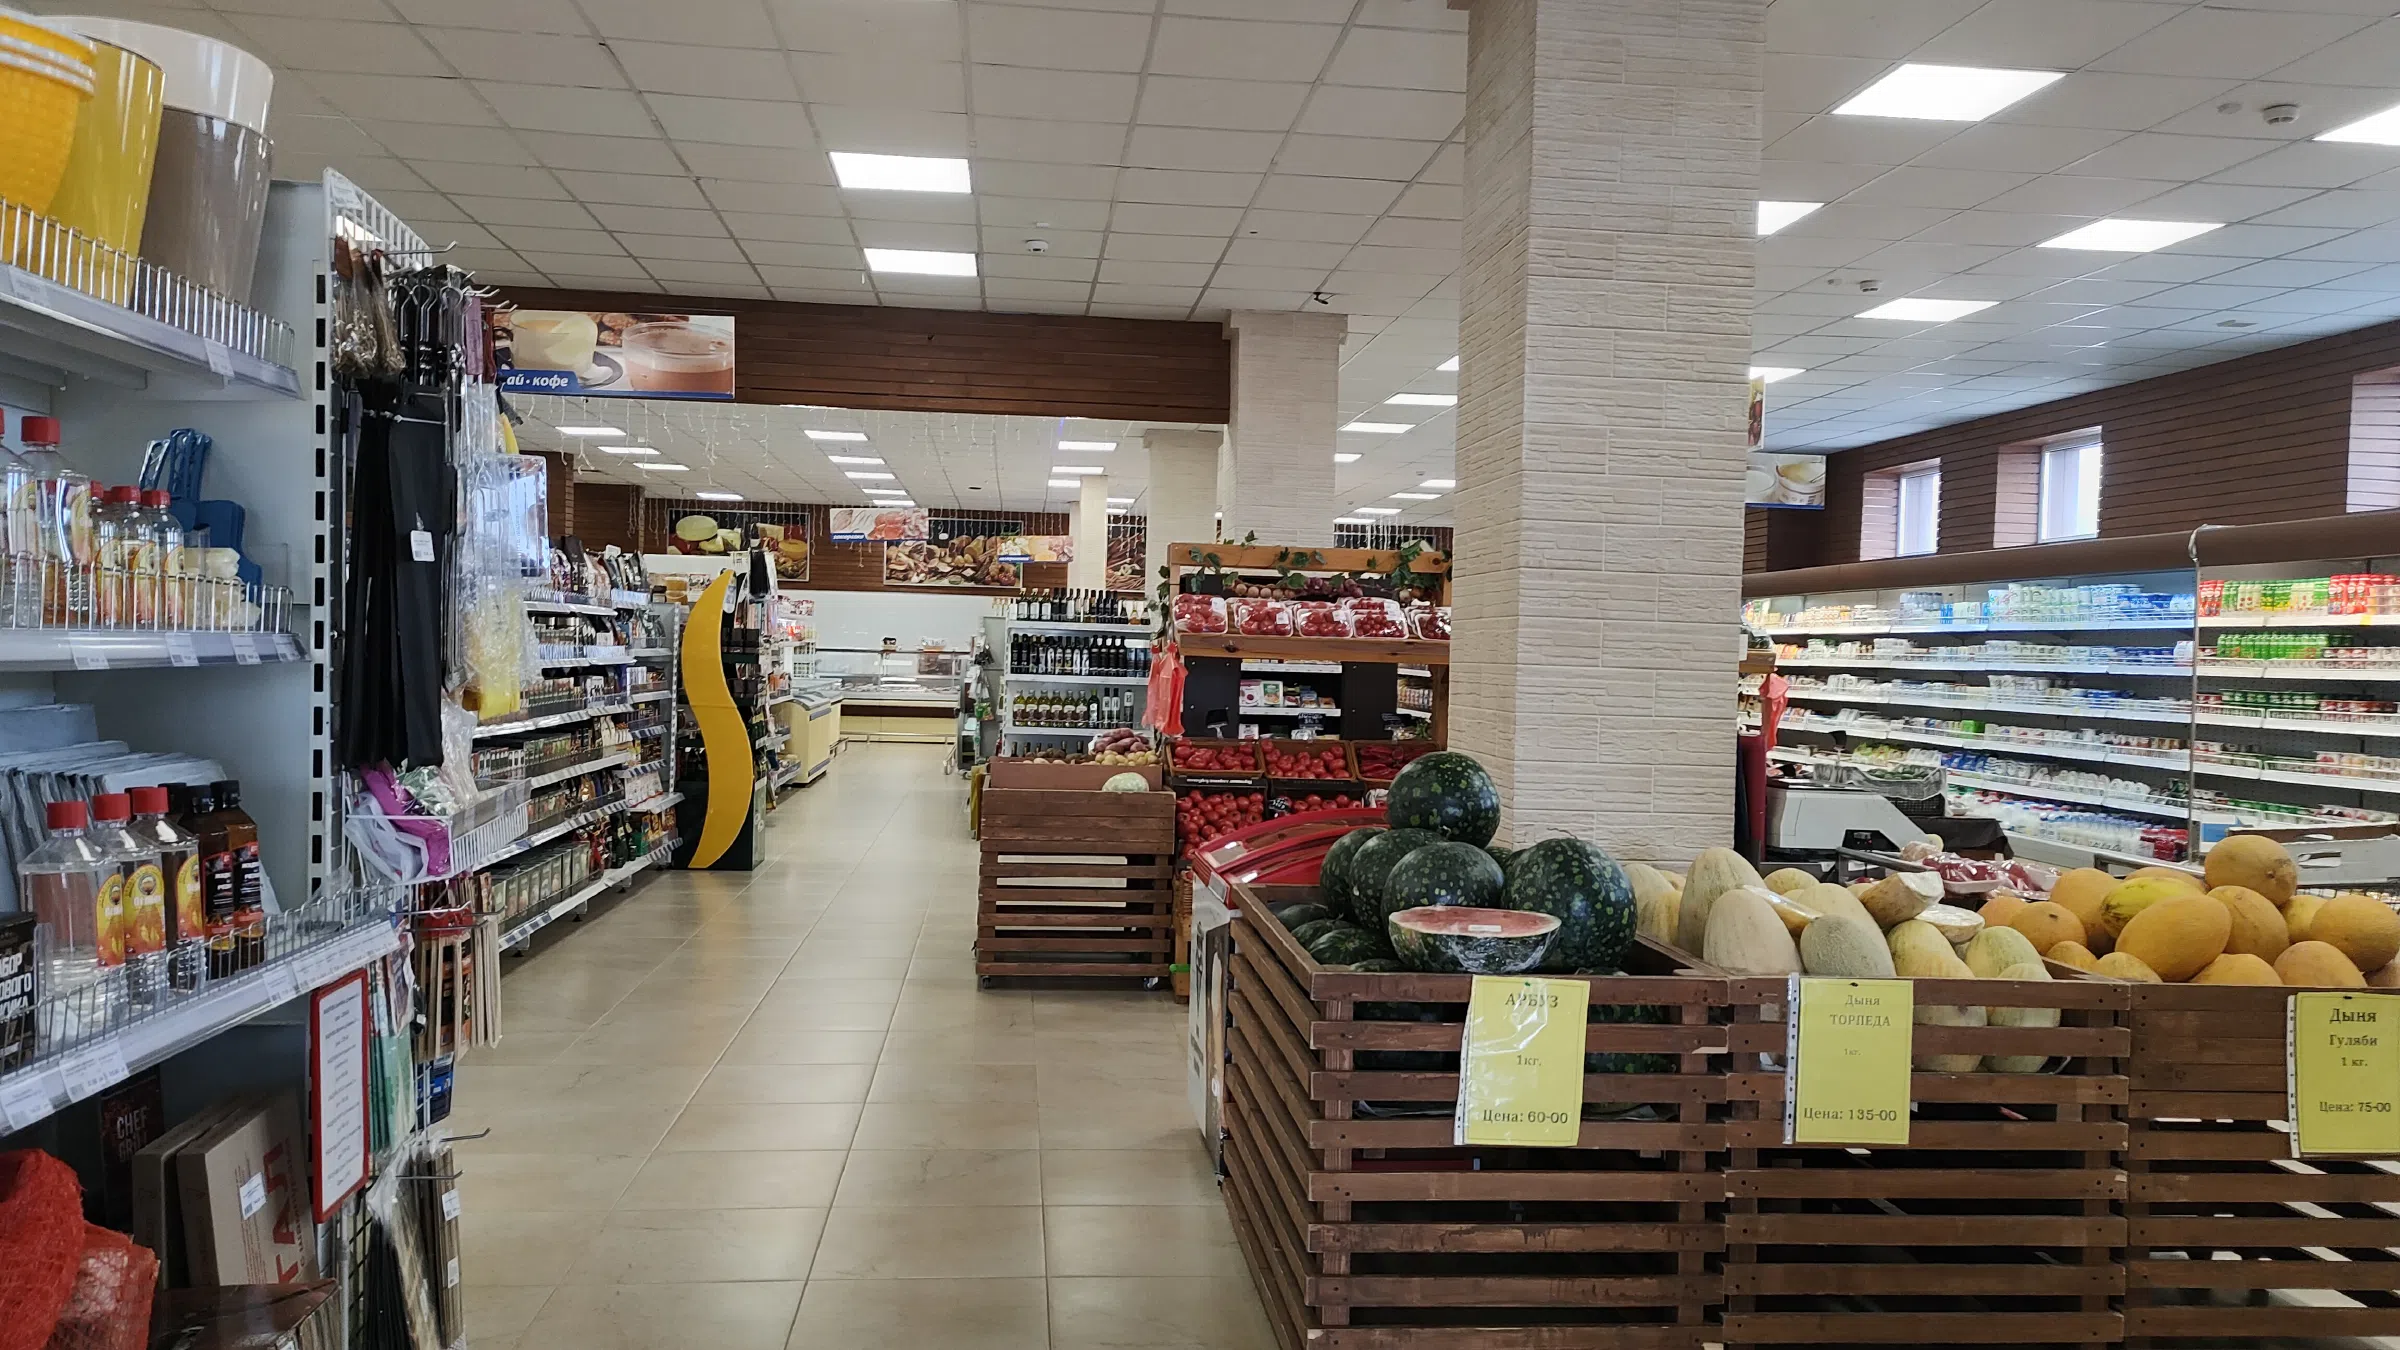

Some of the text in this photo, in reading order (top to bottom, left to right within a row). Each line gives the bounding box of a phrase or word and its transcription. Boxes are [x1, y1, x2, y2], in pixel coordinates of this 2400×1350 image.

[506, 373, 569, 389] ай кофе
[0, 972, 32, 1001] ОВОГО
[1504, 993, 1559, 1008] АРБУЗ
[1845, 994, 1880, 1007] Дыня
[1830, 1014, 1891, 1028] ТОРПЕДА
[2329, 1008, 2377, 1024] Дыня
[2329, 1034, 2378, 1049] Гуляби
[2341, 1057, 2368, 1066] 1 кг.
[1804, 1107, 1897, 1121] Цена: 135-00
[2319, 1101, 2391, 1113] Цена: 75-00
[116, 1105, 151, 1140] CHEF
[1483, 1109, 1568, 1124] Цена: 60-00
